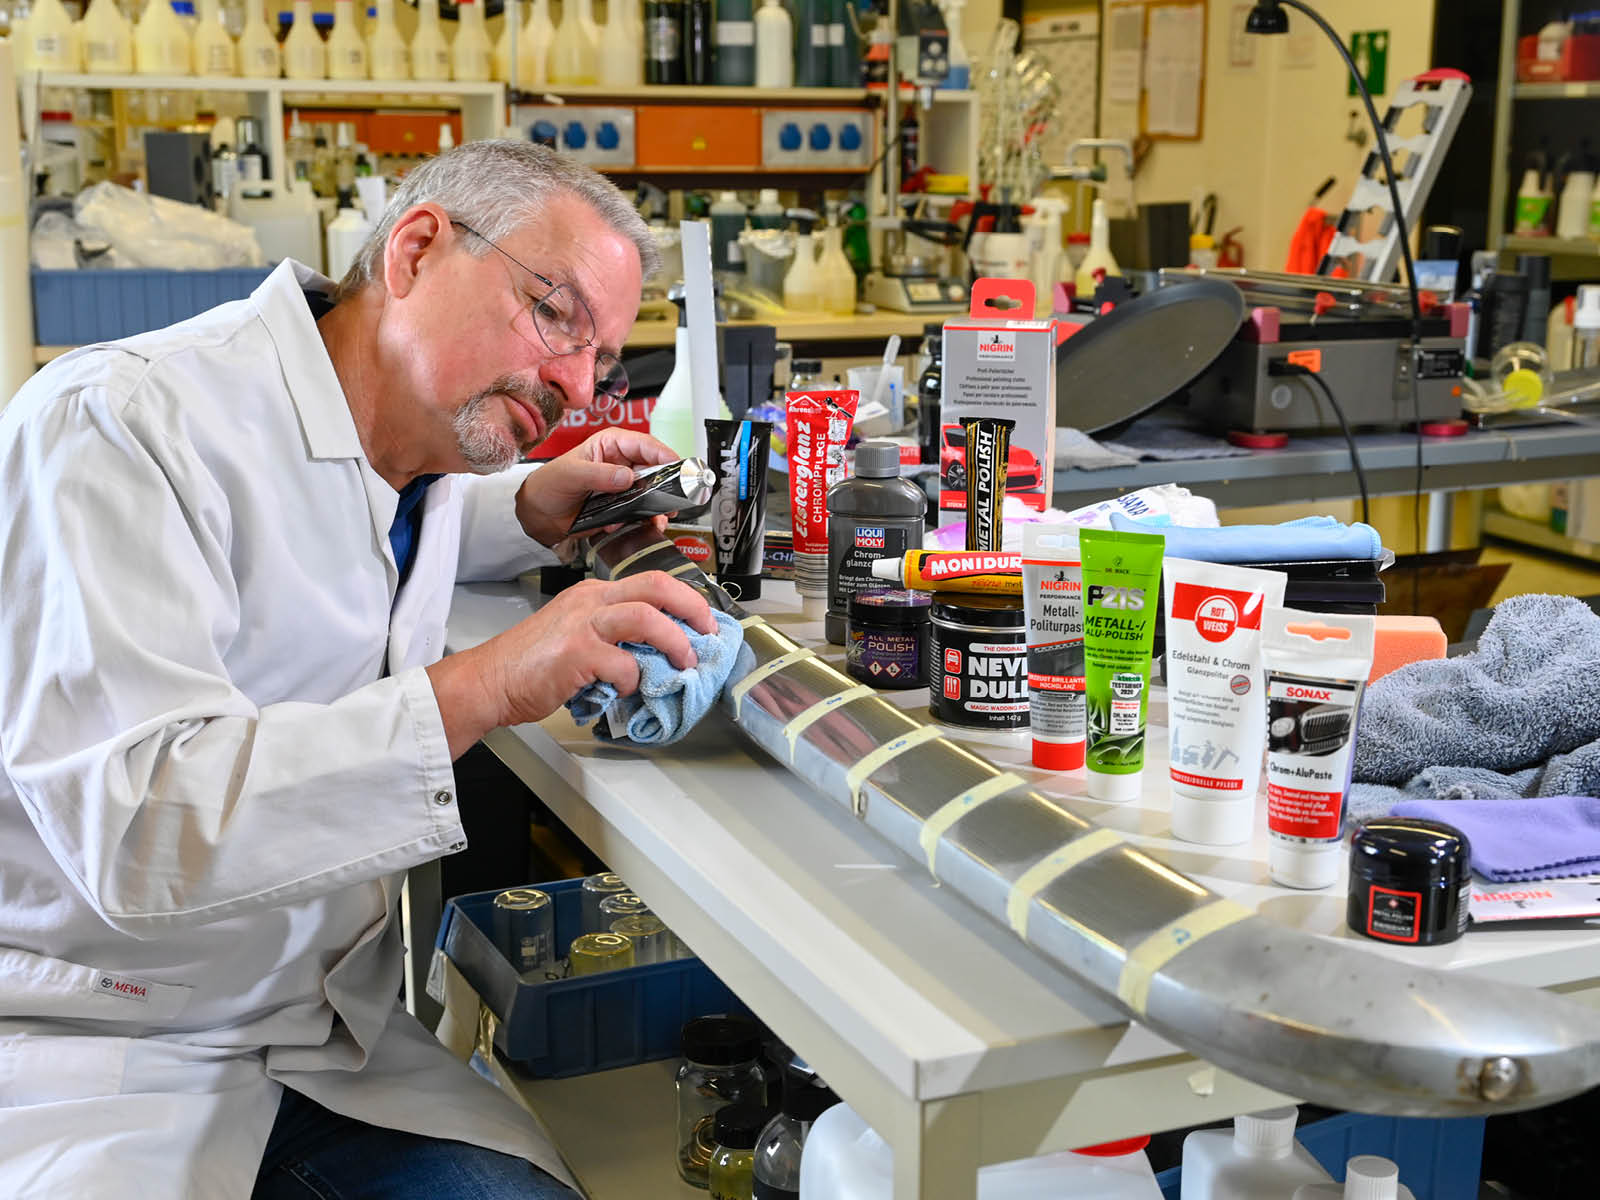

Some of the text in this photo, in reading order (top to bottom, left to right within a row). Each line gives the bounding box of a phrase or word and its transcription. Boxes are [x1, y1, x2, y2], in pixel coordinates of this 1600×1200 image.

[980, 344, 1014, 352] NIGRIN
[563, 398, 652, 428] BSOLU
[978, 430, 993, 493] POLISH
[813, 433, 826, 523] CHROMPFLEGE
[857, 528, 883, 537] LIQUI
[856, 538, 883, 547] MOLY
[677, 545, 708, 555] TOSOL
[931, 556, 1022, 576] MONIDUR
[1041, 580, 1082, 591] NIGRIN
[1043, 605, 1079, 617] Metall-
[1210, 607, 1226, 617] ROT
[1203, 620, 1229, 633] WEISS
[1085, 628, 1143, 640] ALU-POLISH
[868, 642, 915, 652] POLISH
[1172, 650, 1250, 671] Edelstahl & Chrom
[1286, 687, 1331, 700] SONAX
[113, 981, 147, 996] MEWA
